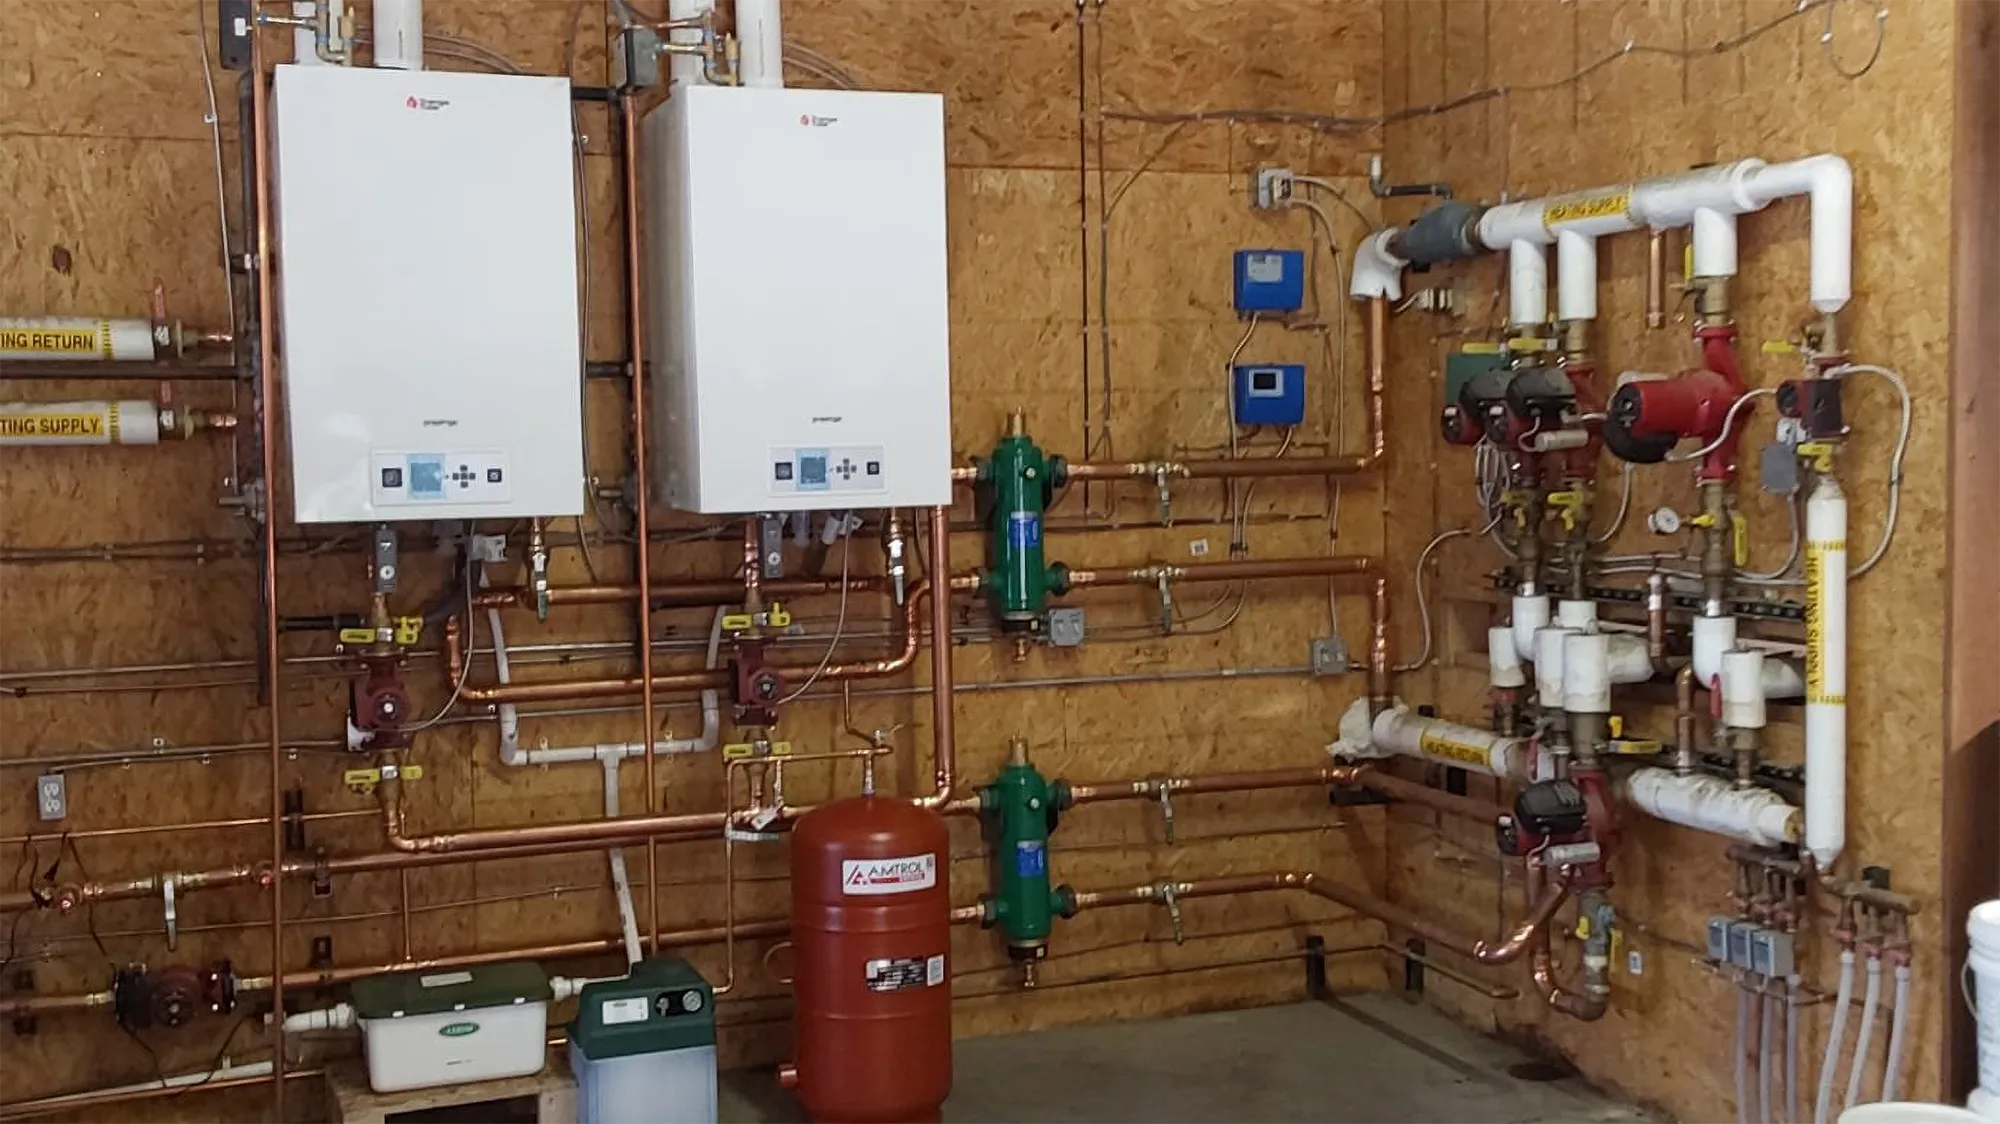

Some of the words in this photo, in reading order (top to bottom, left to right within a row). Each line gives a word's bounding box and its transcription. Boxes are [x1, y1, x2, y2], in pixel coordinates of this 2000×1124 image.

[0, 333, 28, 348] ING
[32, 334, 93, 349] RETURN
[40, 418, 99, 433] SUPPLY
